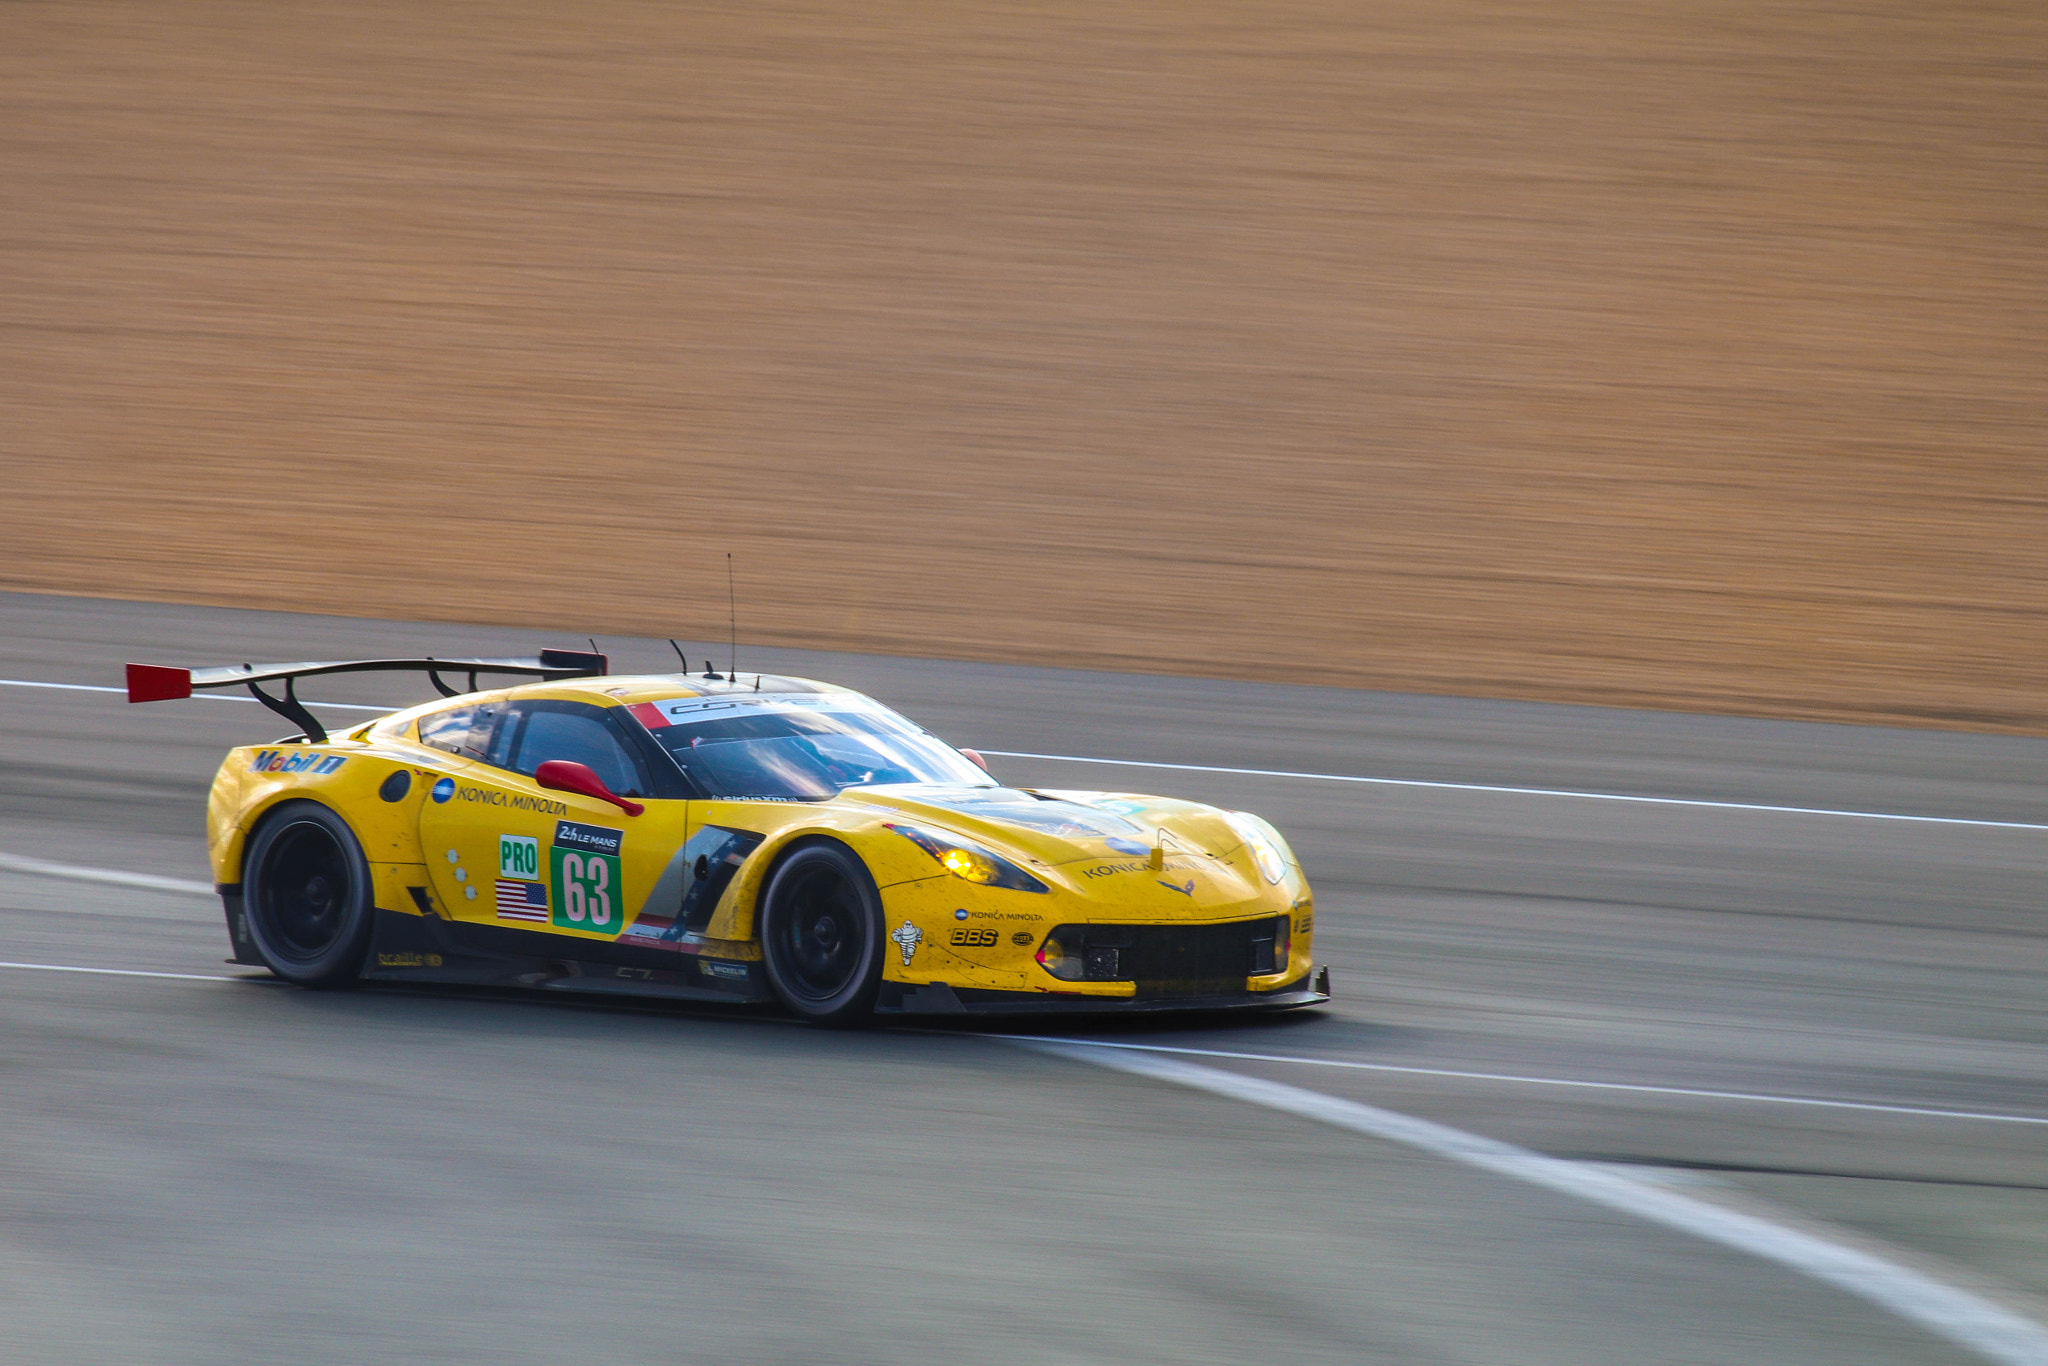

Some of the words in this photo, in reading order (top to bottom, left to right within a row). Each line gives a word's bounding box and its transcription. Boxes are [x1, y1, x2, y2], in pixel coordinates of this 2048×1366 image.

[458, 786, 507, 807] KONICA
[509, 796, 567, 816] MINOLTA
[577, 834, 591, 843] LE
[589, 835, 618, 848] MANS
[501, 840, 537, 874] PRO
[563, 853, 611, 925] 63
[971, 911, 1005, 920] KONICA
[1006, 913, 1044, 921] MINOLTA
[950, 927, 999, 947] BBS
[713, 965, 748, 976] MICHELIN
